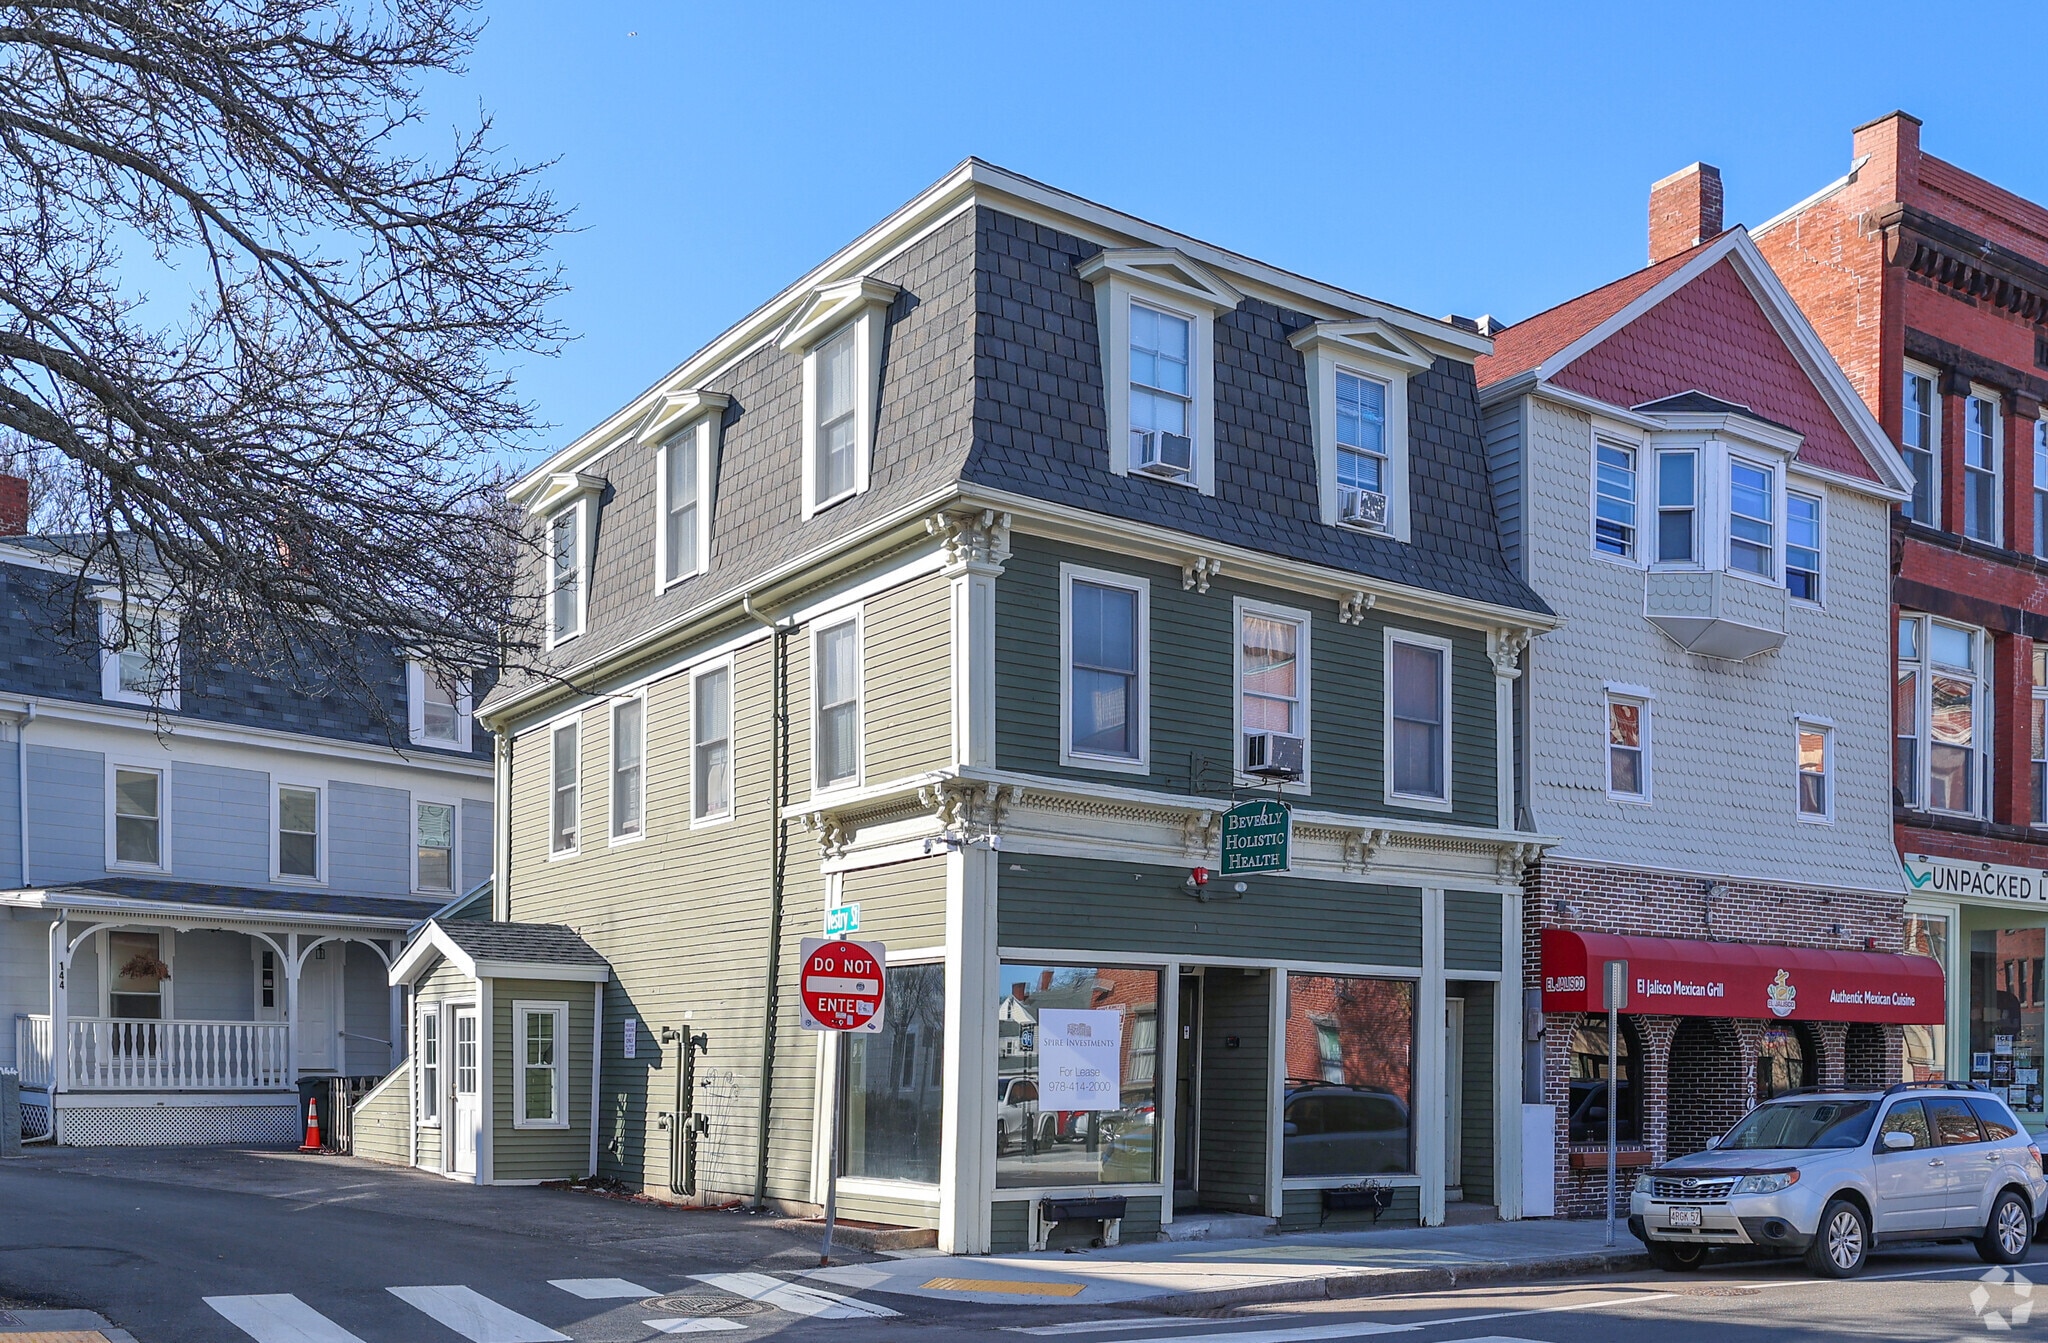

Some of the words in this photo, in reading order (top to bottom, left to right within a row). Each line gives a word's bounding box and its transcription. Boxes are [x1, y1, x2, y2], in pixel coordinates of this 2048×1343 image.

[1228, 812, 1283, 830] BEVERLY
[1225, 832, 1285, 850] HOLISTIC
[1228, 853, 1280, 869] HEALTH
[1932, 866, 2031, 899] UNPACKED
[814, 957, 834, 972] DO
[844, 959, 872, 974] NOT
[1545, 976, 1556, 992] EL
[1555, 975, 1586, 992] JALISCO
[1636, 978, 1645, 994] El
[1646, 979, 1672, 998] Jalisco
[1673, 980, 1706, 997] Mexican
[1707, 981, 1724, 997] Grill
[818, 997, 863, 1013] ENTE
[1829, 988, 1863, 1004] Authentic
[1864, 990, 1891, 1005] Mexican
[1892, 991, 1916, 1007] Cuisine
[1043, 1038, 1064, 1047] SPIRE
[1066, 1038, 1114, 1047] INVESTMENTS
[1059, 1066, 1073, 1077] For
[1075, 1066, 1100, 1077] Lease
[1048, 1081, 1111, 1092] 978-414-2000
[1690, 1211, 1699, 1221] 57
